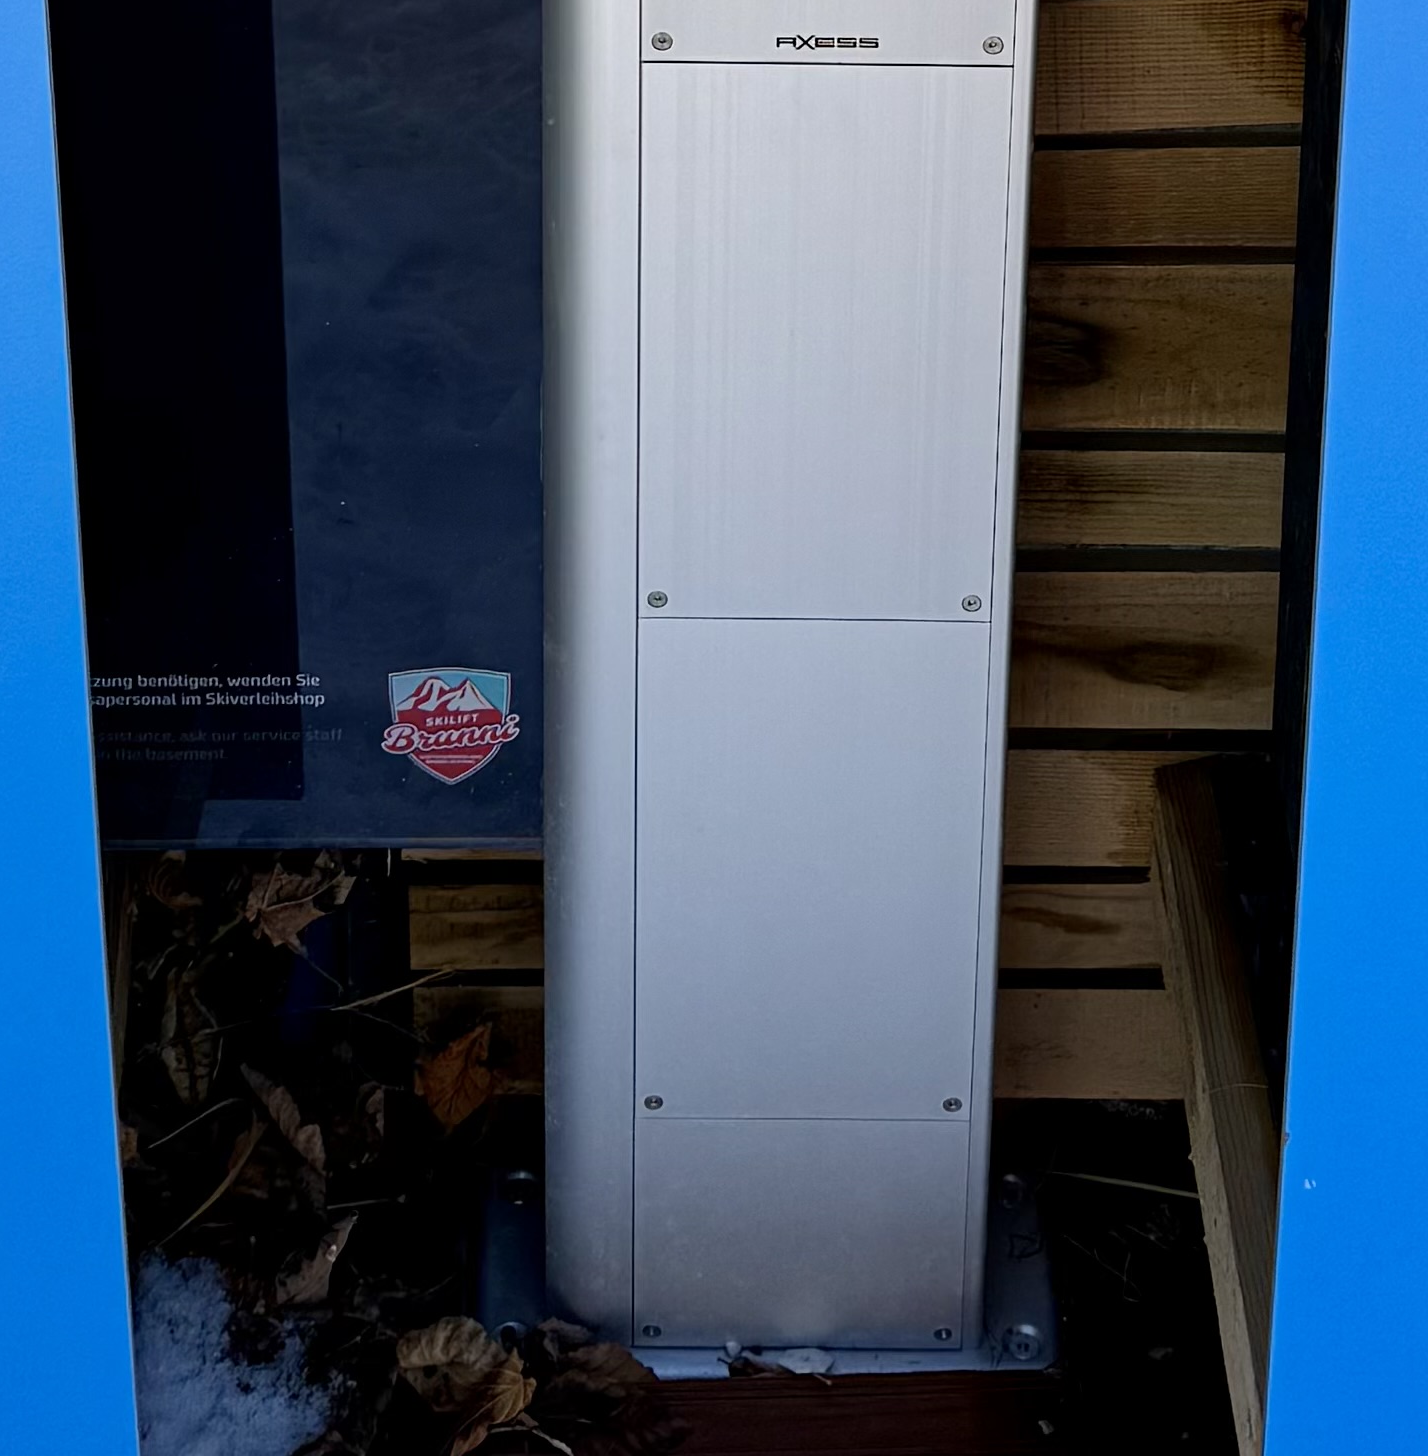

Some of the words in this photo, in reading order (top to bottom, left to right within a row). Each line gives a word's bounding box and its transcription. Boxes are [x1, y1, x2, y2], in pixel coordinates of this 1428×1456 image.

[776, 34, 879, 50] AXESS
[91, 677, 133, 691] zung
[137, 673, 223, 691] benötigen,
[227, 674, 292, 688] wenden
[295, 673, 321, 688] Sie
[180, 692, 203, 706] im
[205, 691, 326, 708] Skiverleihshop
[425, 712, 480, 728] SKILIFT
[381, 713, 521, 756] Brunni
